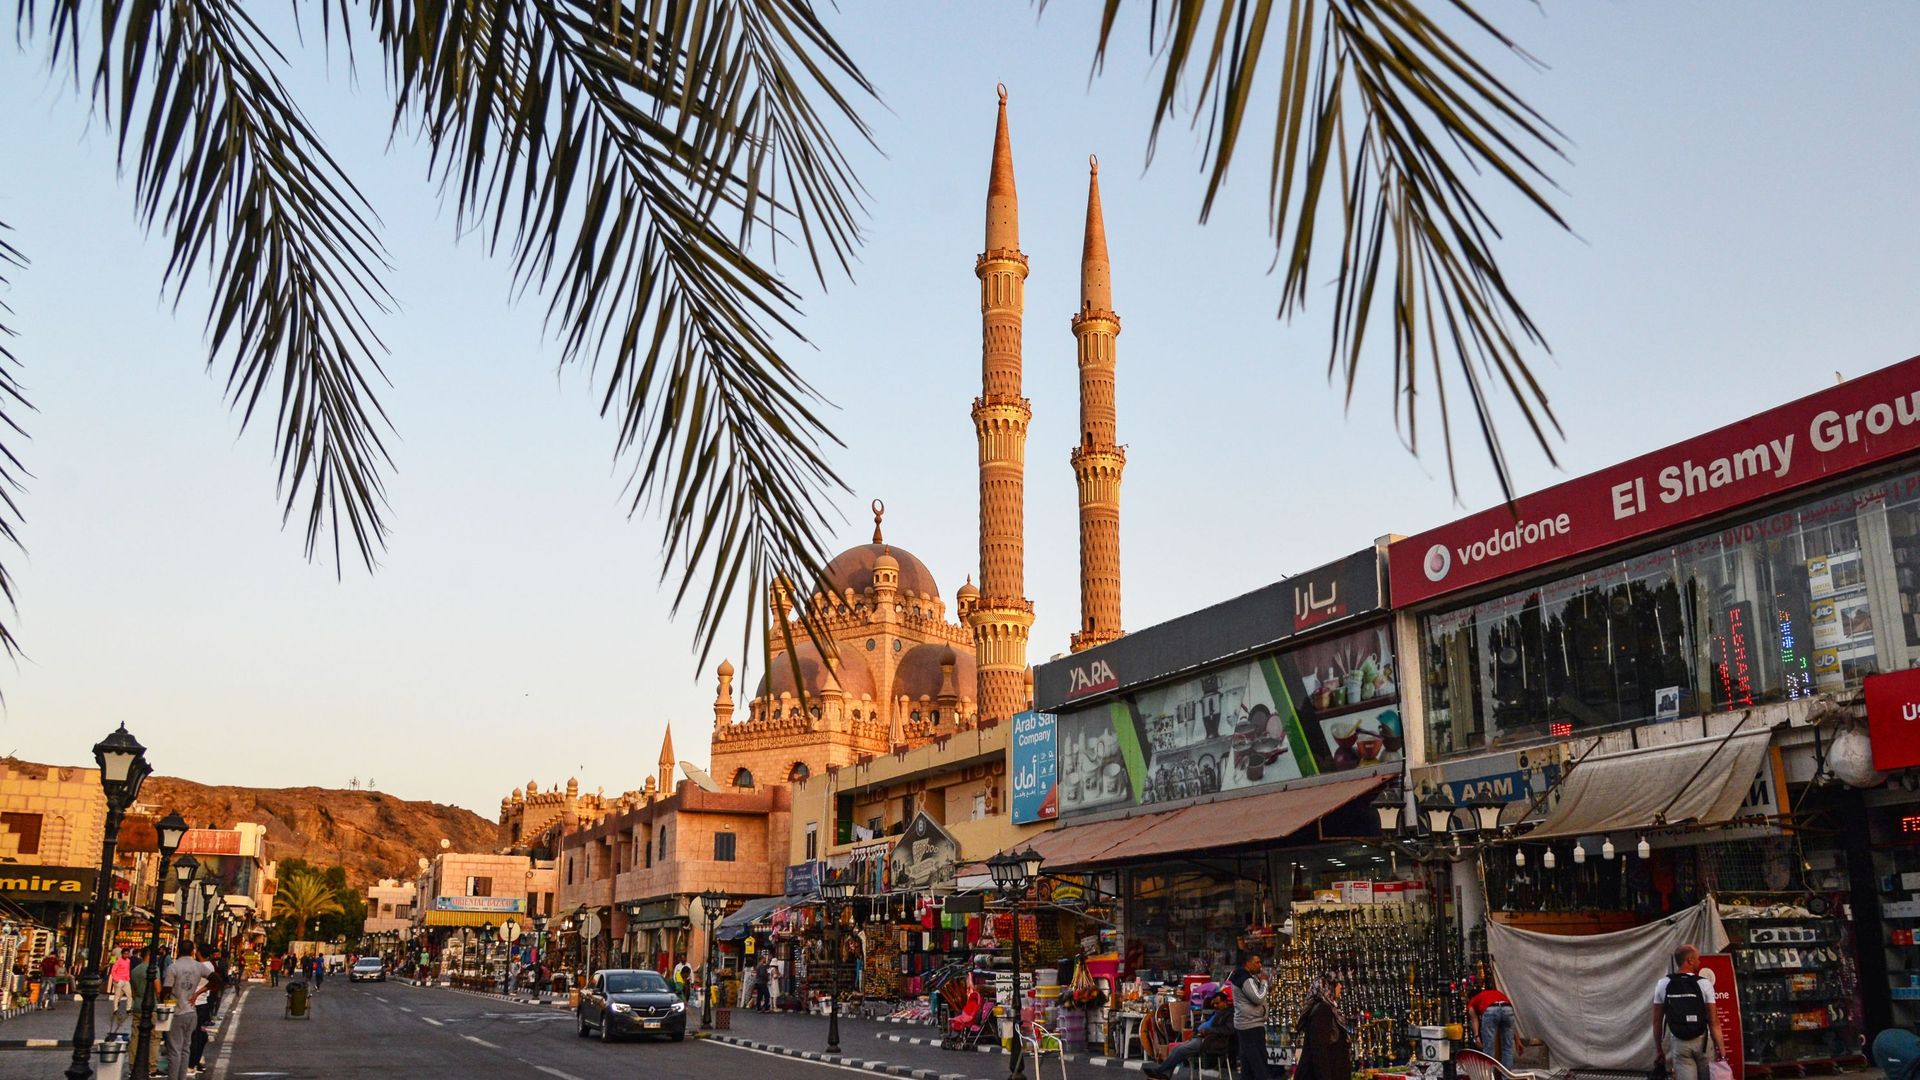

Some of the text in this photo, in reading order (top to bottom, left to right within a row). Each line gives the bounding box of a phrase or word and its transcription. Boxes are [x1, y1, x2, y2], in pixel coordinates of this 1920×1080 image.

[1611, 390, 1920, 521] El Shamy Grou
[1457, 513, 1571, 565] vodafone
[1295, 581, 1336, 621] يارا
[1070, 660, 1116, 692] YARA
[1015, 713, 1055, 734] Arab Sat
[1019, 730, 1051, 747] Company
[0, 876, 82, 892] mira
